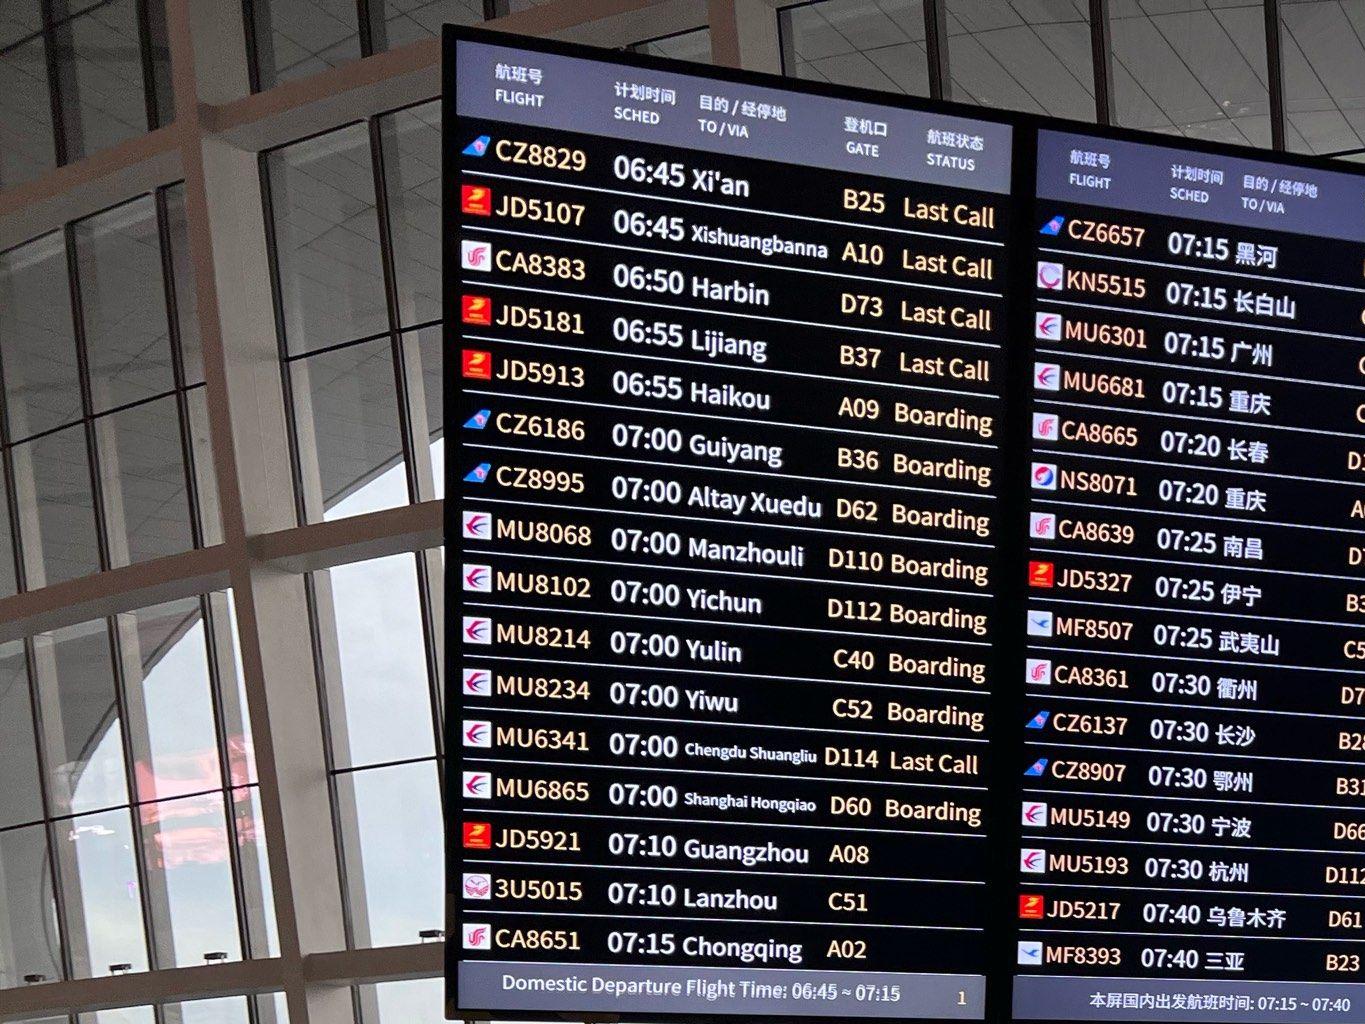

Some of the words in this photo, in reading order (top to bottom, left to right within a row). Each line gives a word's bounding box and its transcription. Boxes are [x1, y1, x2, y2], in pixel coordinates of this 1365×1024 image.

[495, 63, 542, 85] 航班号
[614, 82, 676, 105] 计划时间
[700, 95, 729, 113] 目的
[741, 101, 786, 122] 经停地
[844, 117, 887, 137] 登机口
[927, 129, 983, 151] 航班状态
[496, 89, 544, 107] FLIGHT
[614, 107, 659, 124] SCHED
[698, 119, 717, 133] TO
[727, 123, 748, 138] VIA
[846, 141, 879, 157] GATE
[927, 153, 975, 171] STATUS
[496, 140, 586, 171] CZ8829
[614, 155, 685, 187] 06:45
[692, 169, 749, 197] Xi'an
[844, 189, 885, 213] B25
[904, 198, 948, 222] Last
[954, 205, 993, 228] Call
[1070, 150, 1110, 169] 航班号
[1171, 165, 1223, 185] 计划时间
[1243, 175, 1269, 191] 目的
[1278, 180, 1318, 198] 经停地
[1070, 173, 1111, 189] FLIGHT
[1170, 187, 1209, 203] SCHED
[1241, 197, 1258, 210] TO
[1266, 201, 1285, 214] VIA
[496, 196, 585, 225] JD5107
[614, 210, 684, 241] 06:45
[692, 225, 828, 258] Xishuangbanna
[842, 242, 883, 265] A10
[903, 249, 947, 273] Last
[952, 256, 992, 280] Call
[1069, 220, 1145, 247] CZ6657
[1168, 232, 1229, 260] 07:15
[1236, 242, 1278, 268] 黑河
[1067, 270, 1145, 298] KN5515
[1166, 282, 1227, 310] 07:15
[1234, 290, 1295, 319] 长白山
[496, 305, 584, 334] JD5181
[613, 318, 683, 347] 06:55
[692, 330, 767, 363] Lijiang
[841, 345, 881, 368] B37
[901, 352, 944, 376] Last
[949, 358, 989, 381] Call
[1066, 321, 1146, 348] MU6301
[1165, 332, 1224, 359] 07:15
[1231, 341, 1272, 366] 广州
[497, 413, 585, 440] CZ6186
[613, 424, 682, 452] 07:00
[690, 435, 782, 468] Guiyang
[838, 448, 878, 470] B36
[894, 454, 991, 487] Boarding
[1062, 421, 1137, 446] CA8665
[1161, 431, 1220, 457] 07:20
[1227, 439, 1268, 463] 长春
[497, 466, 584, 493] CZ8995
[612, 476, 681, 504] 07:00
[688, 486, 746, 515] Altay
[751, 492, 821, 517] Xuedu
[837, 499, 877, 521] D62
[893, 504, 989, 537] Boarding
[1061, 470, 1137, 495] NS8071
[1159, 480, 1218, 505] 07:20
[1225, 488, 1266, 512] 重庆
[497, 572, 590, 597] MU8102
[611, 580, 680, 606] 07:00
[687, 589, 761, 613] Yichun
[828, 599, 881, 621] D112
[890, 604, 987, 635] Boarding
[1057, 569, 1132, 592] JD5327
[1156, 576, 1214, 601] 07:25
[1221, 583, 1261, 606] 伊宁
[1055, 666, 1128, 688] CA8361
[1152, 672, 1211, 696] 07:30
[1217, 678, 1257, 700] 衢州
[497, 727, 589, 750] MU6341
[610, 733, 678, 758] 07:00
[685, 743, 746, 760] Chengdu
[750, 747, 817, 765] Shuangliu
[825, 747, 878, 768] D114
[891, 752, 934, 771] Last
[939, 755, 978, 774] Call
[1052, 761, 1126, 782] CZ8907
[1149, 766, 1207, 788] 07:30
[1213, 771, 1253, 792] 鄂州
[497, 778, 589, 801] MU6865
[609, 783, 677, 807] 07:00
[684, 792, 748, 810] Shanghai
[751, 797, 816, 813] Hongqiao
[831, 796, 871, 816] D60
[886, 799, 981, 827] Boarding
[496, 829, 580, 851] JD5921
[609, 833, 676, 857] 07:10
[684, 839, 808, 866] Guangzhou
[829, 845, 869, 864] A08
[1047, 901, 1120, 919] JD5217
[1143, 903, 1200, 924] 07:40
[1207, 907, 1286, 928] 乌鲁木齐
[1329, 911, 1362, 928] D61
[496, 929, 580, 950] CA8651
[608, 932, 675, 954] 07:15
[683, 936, 802, 964] Chongqing
[827, 940, 866, 958] A02
[1047, 946, 1121, 965] MF8393
[1141, 948, 1198, 968] 07:40
[1205, 952, 1244, 970] 三亚
[1326, 955, 1359, 971] B23
[503, 975, 587, 991] Domestic
[592, 977, 682, 998] Departure
[685, 979, 736, 1001] Flight
[739, 980, 787, 999] Time:
[792, 983, 838, 1000] 06:45
[856, 984, 900, 1001] 07:15
[958, 991, 966, 1005] 1
[1258, 997, 1297, 1010] 07:15
[1312, 998, 1351, 1011] 07:40
